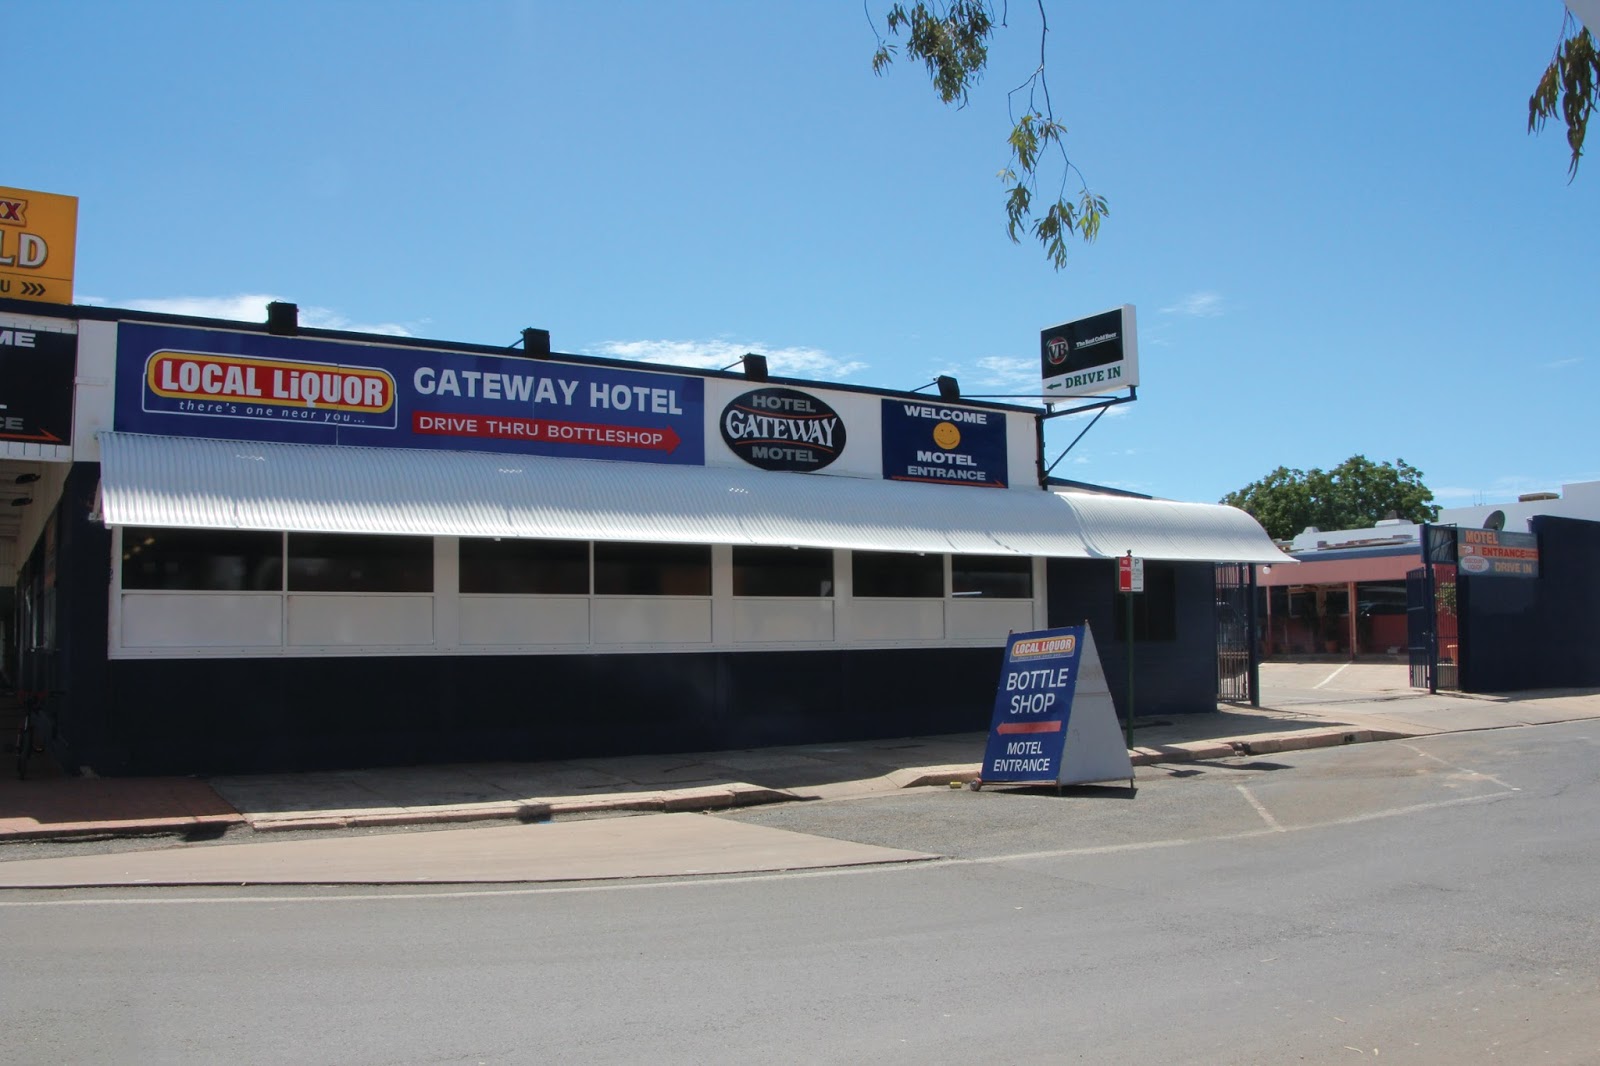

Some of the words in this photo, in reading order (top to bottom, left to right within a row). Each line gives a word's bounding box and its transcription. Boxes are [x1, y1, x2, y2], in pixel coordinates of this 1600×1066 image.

[1049, 341, 1069, 359] VB
[161, 360, 262, 397] LOCAL
[1065, 370, 1105, 389] DRIVE
[1107, 366, 1121, 380] IN
[413, 366, 579, 406] GATEWAY
[590, 382, 683, 415] HOTEL
[179, 401, 238, 414] there's
[246, 406, 274, 416] one
[281, 408, 317, 420] near
[752, 395, 817, 413] HOTEL
[903, 404, 988, 425] WELCOME
[419, 416, 478, 432] DRIVE
[486, 420, 539, 436] THRU
[547, 425, 663, 446] BOTTLESHOP
[725, 409, 838, 448] GATEWAY
[752, 446, 819, 463] MOTEL
[917, 450, 978, 467] MOTEL
[907, 465, 986, 481] ENTRANCE
[1465, 529, 1499, 545] MOTEL
[1481, 547, 1527, 559] ENTRANCE
[1494, 561, 1521, 573] DRIVE
[1523, 563, 1532, 574] IN
[1015, 642, 1040, 654] LOCAL
[1006, 667, 1069, 692] BOTTLE
[1009, 692, 1056, 715] SHOP
[1006, 741, 1043, 756] MOTEL
[993, 757, 1051, 773] ENTRANCE
